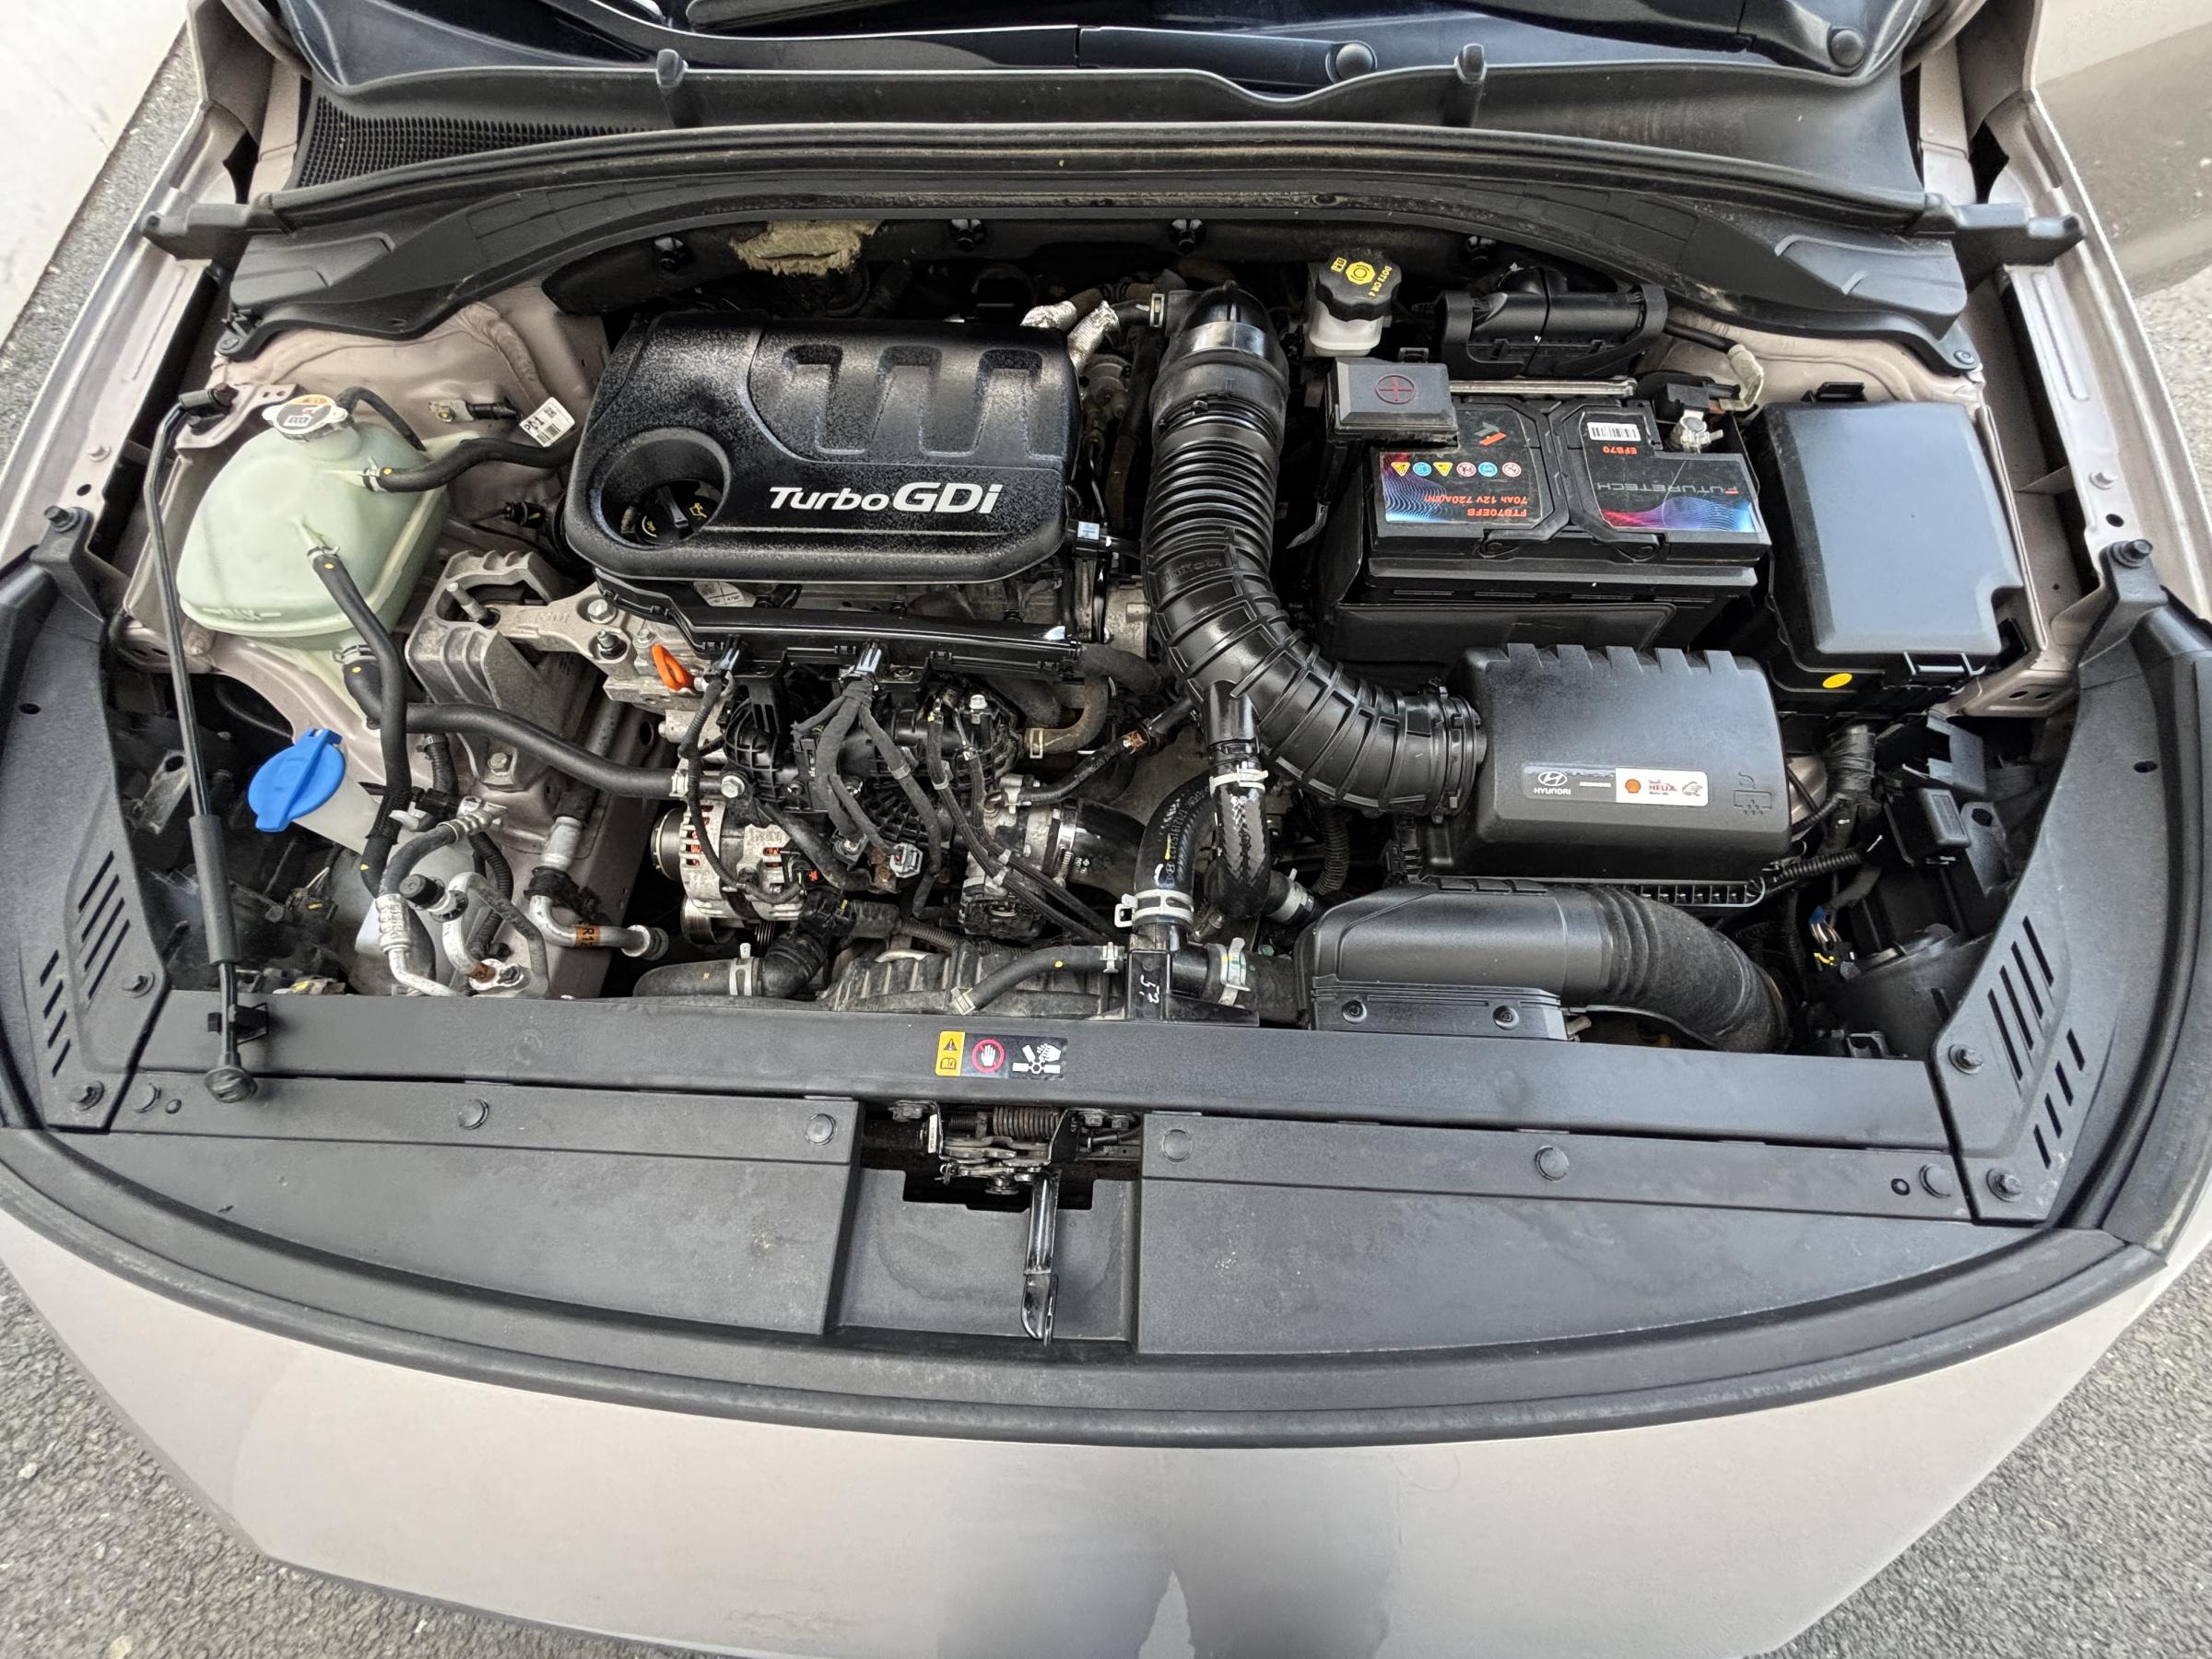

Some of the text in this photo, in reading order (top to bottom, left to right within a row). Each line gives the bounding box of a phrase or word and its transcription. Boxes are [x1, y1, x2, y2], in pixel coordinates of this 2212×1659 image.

[1602, 445, 1638, 454] EFB70
[1596, 481, 1739, 495] FUTURETECH
[1500, 495, 1528, 504] 70Ah
[1466, 508, 1527, 517] FTB70EFB
[1533, 786, 1571, 795] HYUNDAI
